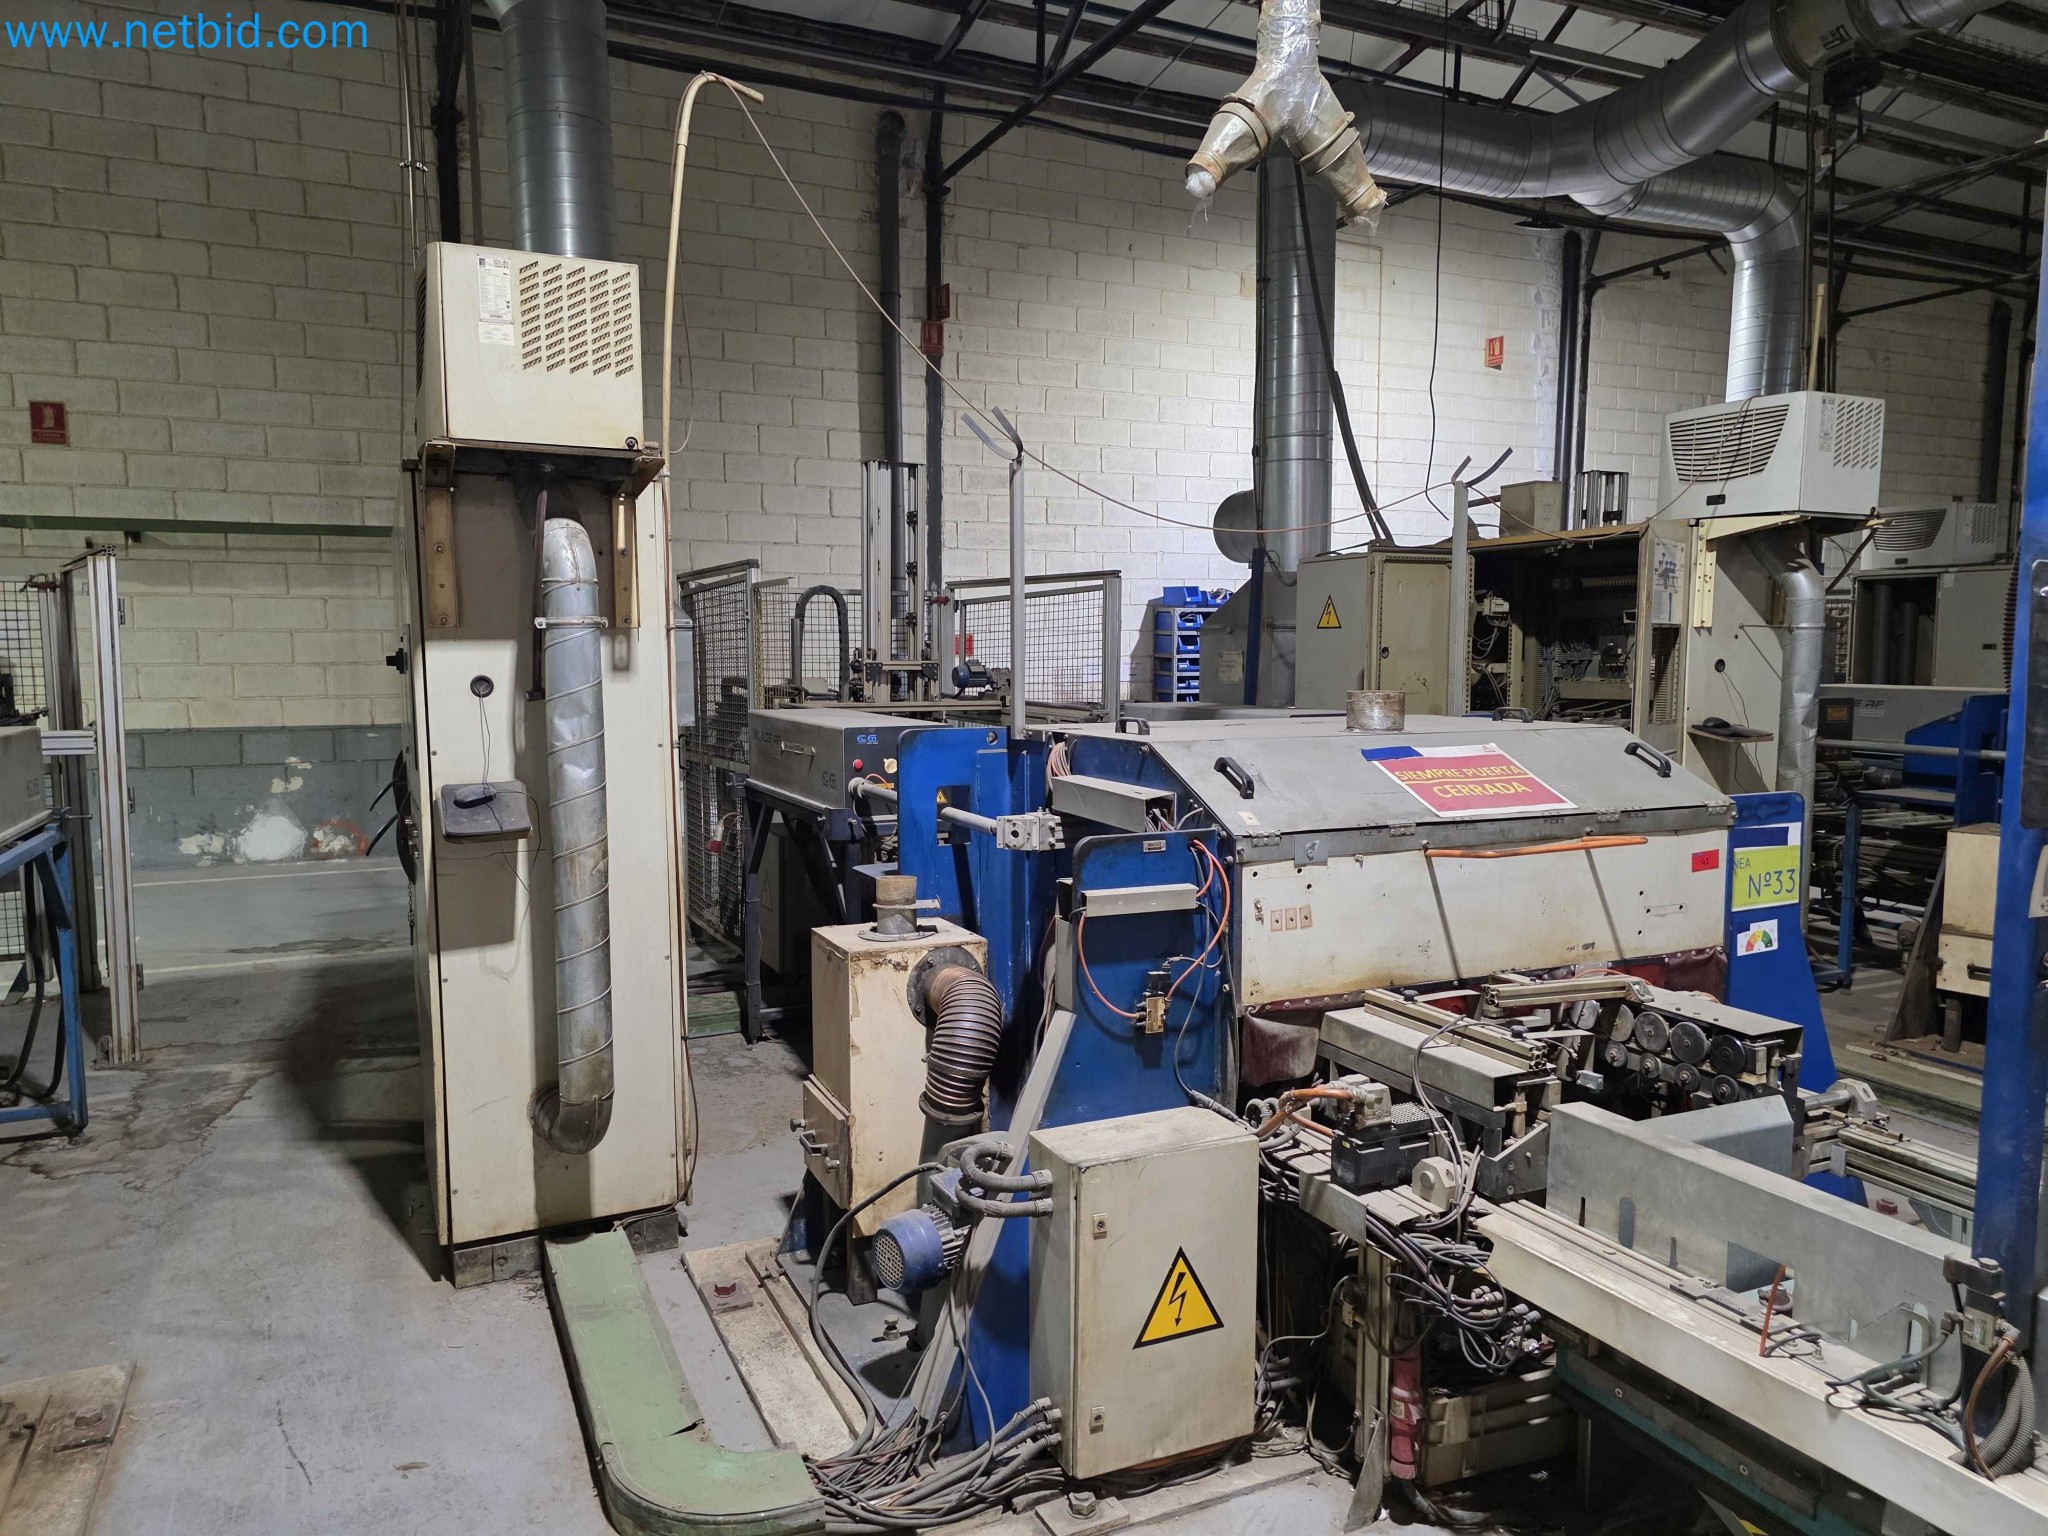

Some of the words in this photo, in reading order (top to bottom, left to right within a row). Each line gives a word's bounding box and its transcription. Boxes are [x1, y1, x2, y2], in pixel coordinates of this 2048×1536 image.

[1394, 767, 1462, 781] SIEMPRE
[1464, 765, 1524, 779] PUERTA
[1432, 781, 1532, 799] CERRADA
